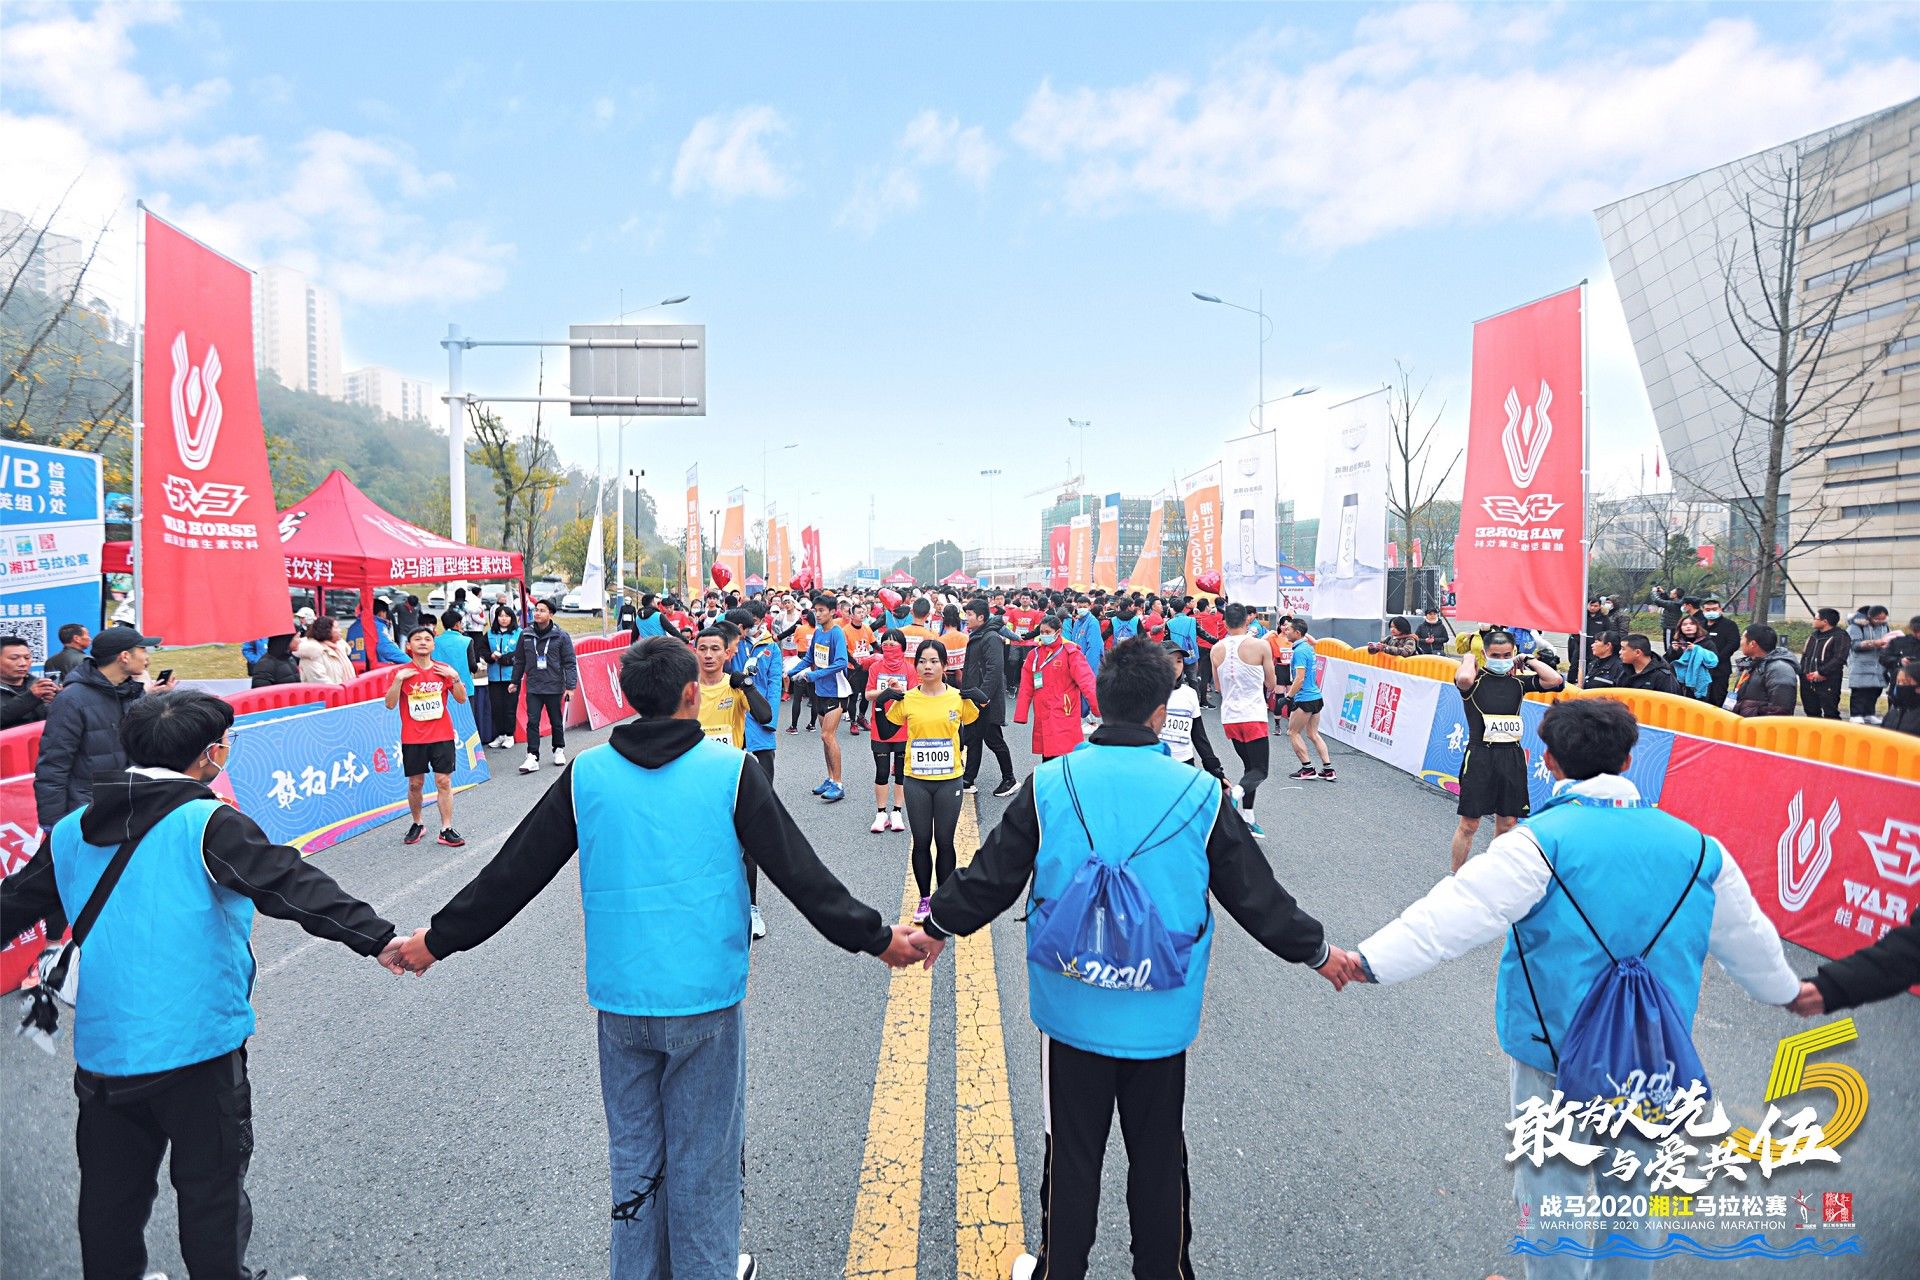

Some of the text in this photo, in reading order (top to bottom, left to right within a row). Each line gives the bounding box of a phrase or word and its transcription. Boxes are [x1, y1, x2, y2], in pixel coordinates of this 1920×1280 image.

[187, 521, 258, 537] HORSE
[390, 556, 512, 579] 战马能量型维生素饮料
[414, 700, 440, 712] A1029
[1490, 721, 1520, 732] A1003
[916, 750, 950, 763] B1009
[1842, 879, 1908, 925] WAR
